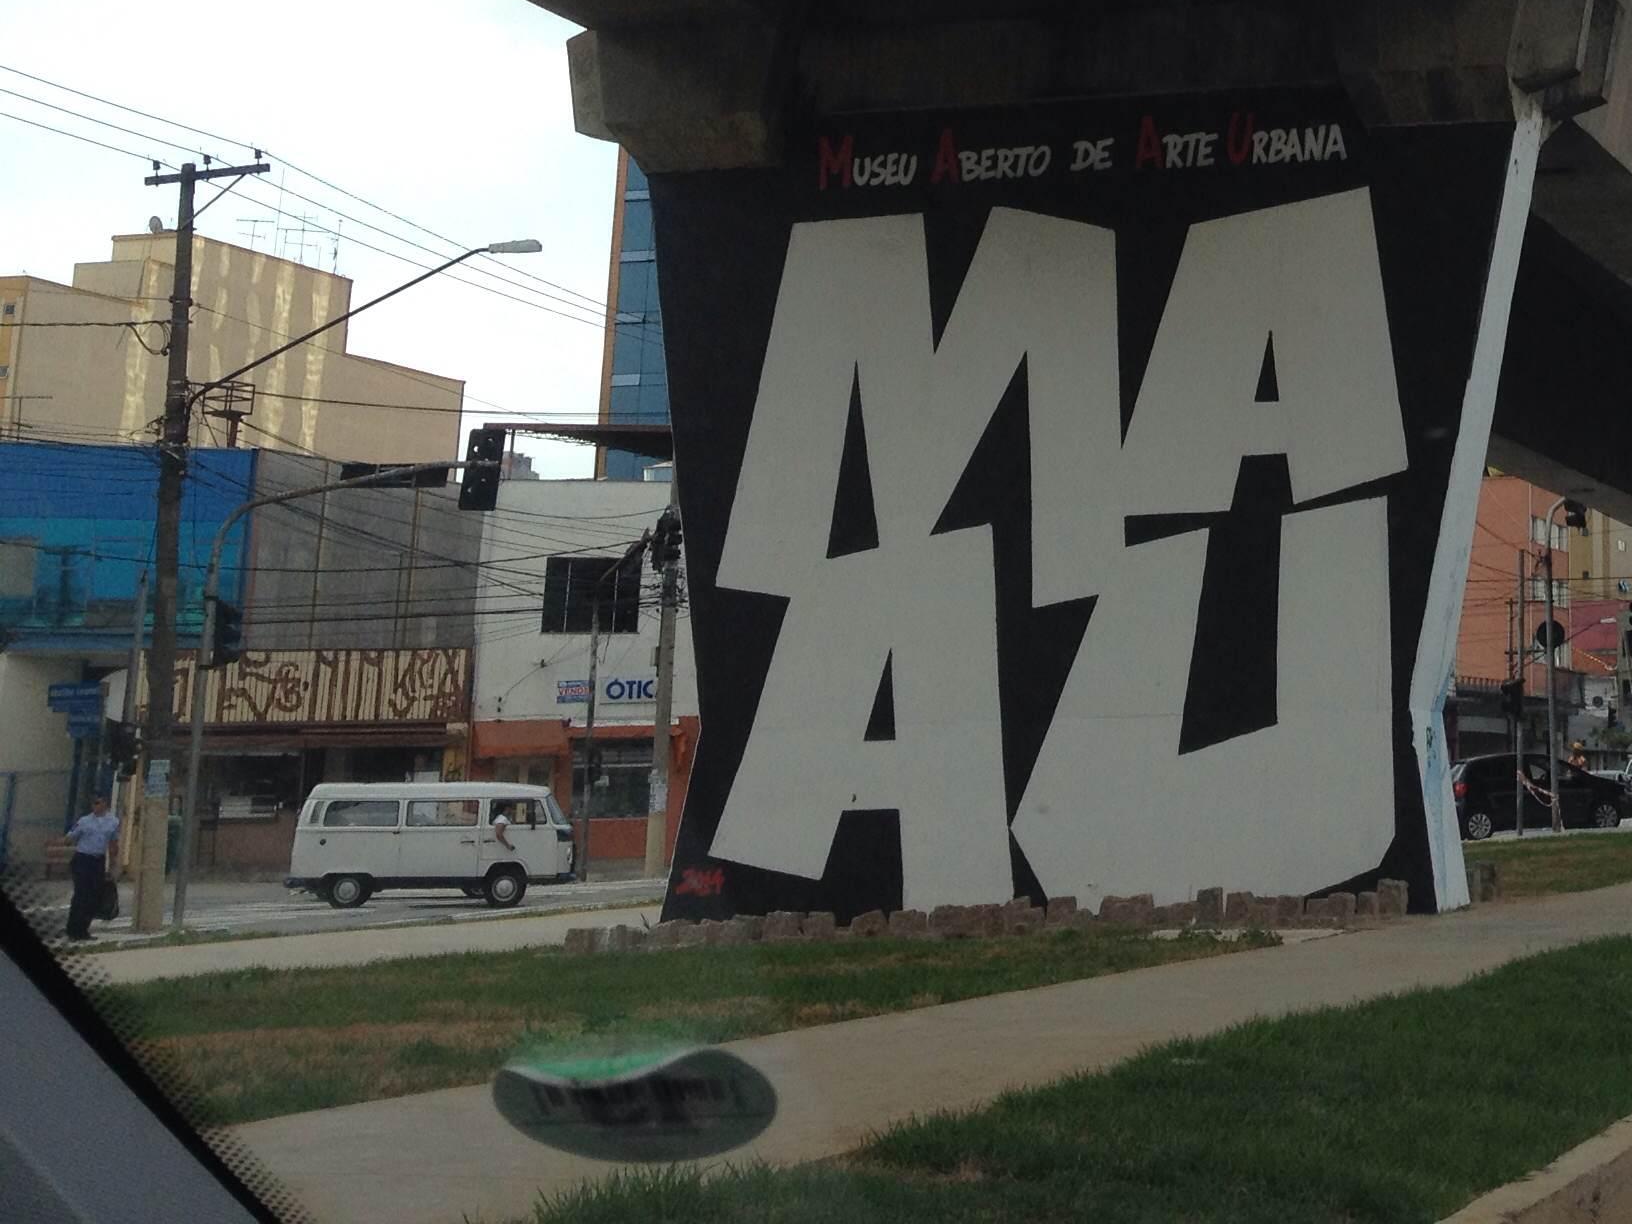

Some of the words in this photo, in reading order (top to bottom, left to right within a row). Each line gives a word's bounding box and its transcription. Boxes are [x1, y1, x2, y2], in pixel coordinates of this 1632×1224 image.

[818, 136, 918, 190] MUSEU
[931, 128, 1052, 183] ABERTO
[1070, 138, 1115, 171] DE
[1136, 115, 1219, 169] ARTE
[1227, 112, 1348, 164] URBANA
[606, 678, 657, 700] ÓTIC
